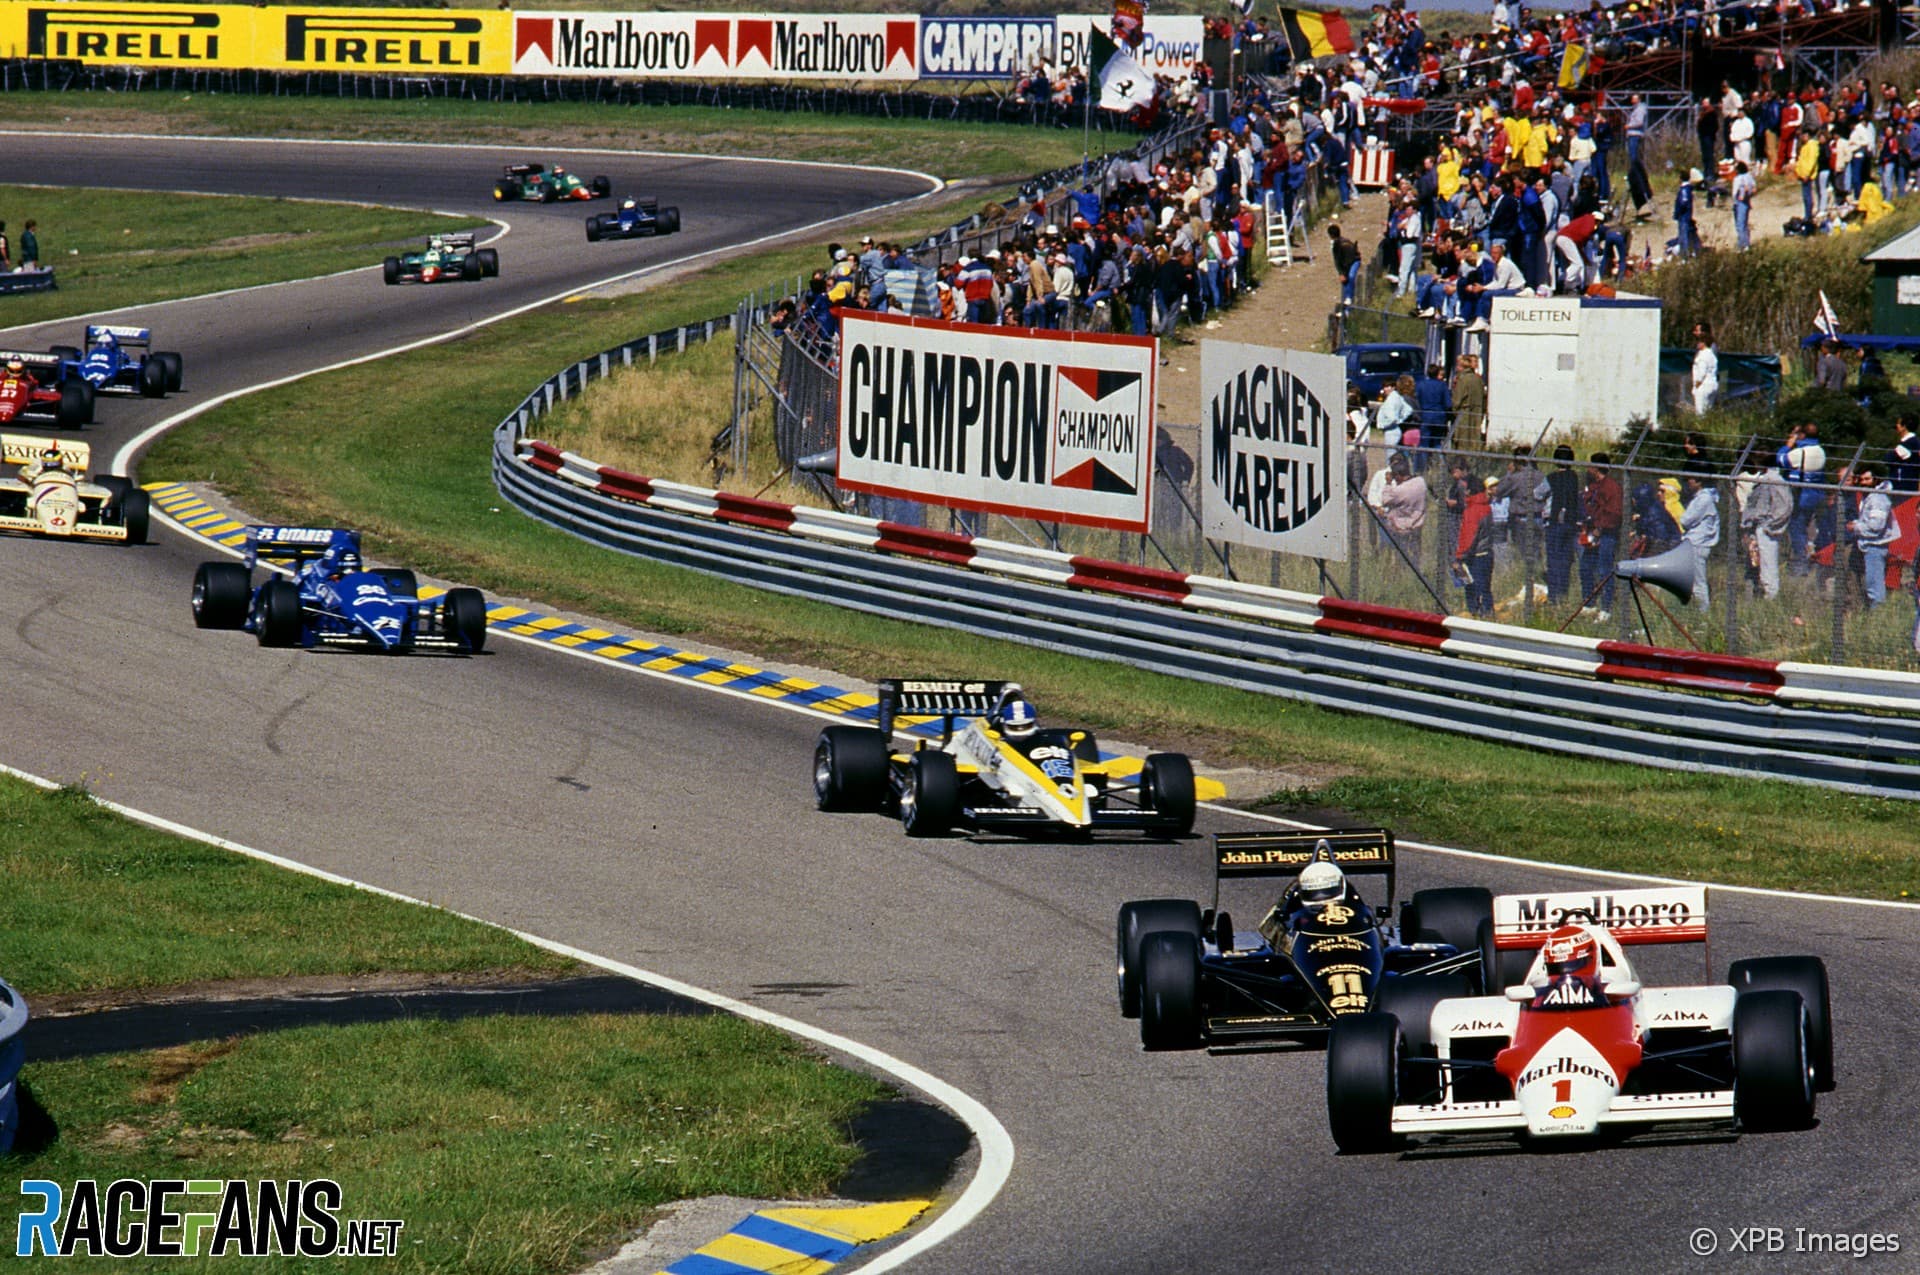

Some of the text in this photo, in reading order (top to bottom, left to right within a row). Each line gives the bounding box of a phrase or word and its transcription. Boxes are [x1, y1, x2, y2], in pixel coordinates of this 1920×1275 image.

[27, 8, 220, 60] PIRELLI
[286, 14, 482, 66] PIRELLI
[557, 18, 690, 70] Marlboro
[775, 21, 885, 74] Marlboro
[923, 22, 1056, 74] CAMPARI
[1061, 31, 1091, 67] BM
[1142, 32, 1200, 68] Power
[1501, 309, 1572, 323] TOILETTEN
[848, 343, 1051, 485] CHAMPION
[1212, 364, 1330, 449] MAGNETI
[1057, 407, 1134, 454] CHAMPION
[3, 443, 83, 464] BARAY
[1212, 451, 1330, 534] MARELLI
[277, 528, 334, 543] GITANES
[902, 681, 986, 694] RENAULT elf
[1029, 745, 1070, 760] elf
[1221, 851, 1263, 865] John
[1327, 973, 1364, 996] 11
[1329, 994, 1369, 1009] elf
[1517, 1057, 1615, 1092] Marlboro
[1552, 1079, 1572, 1103] 1
